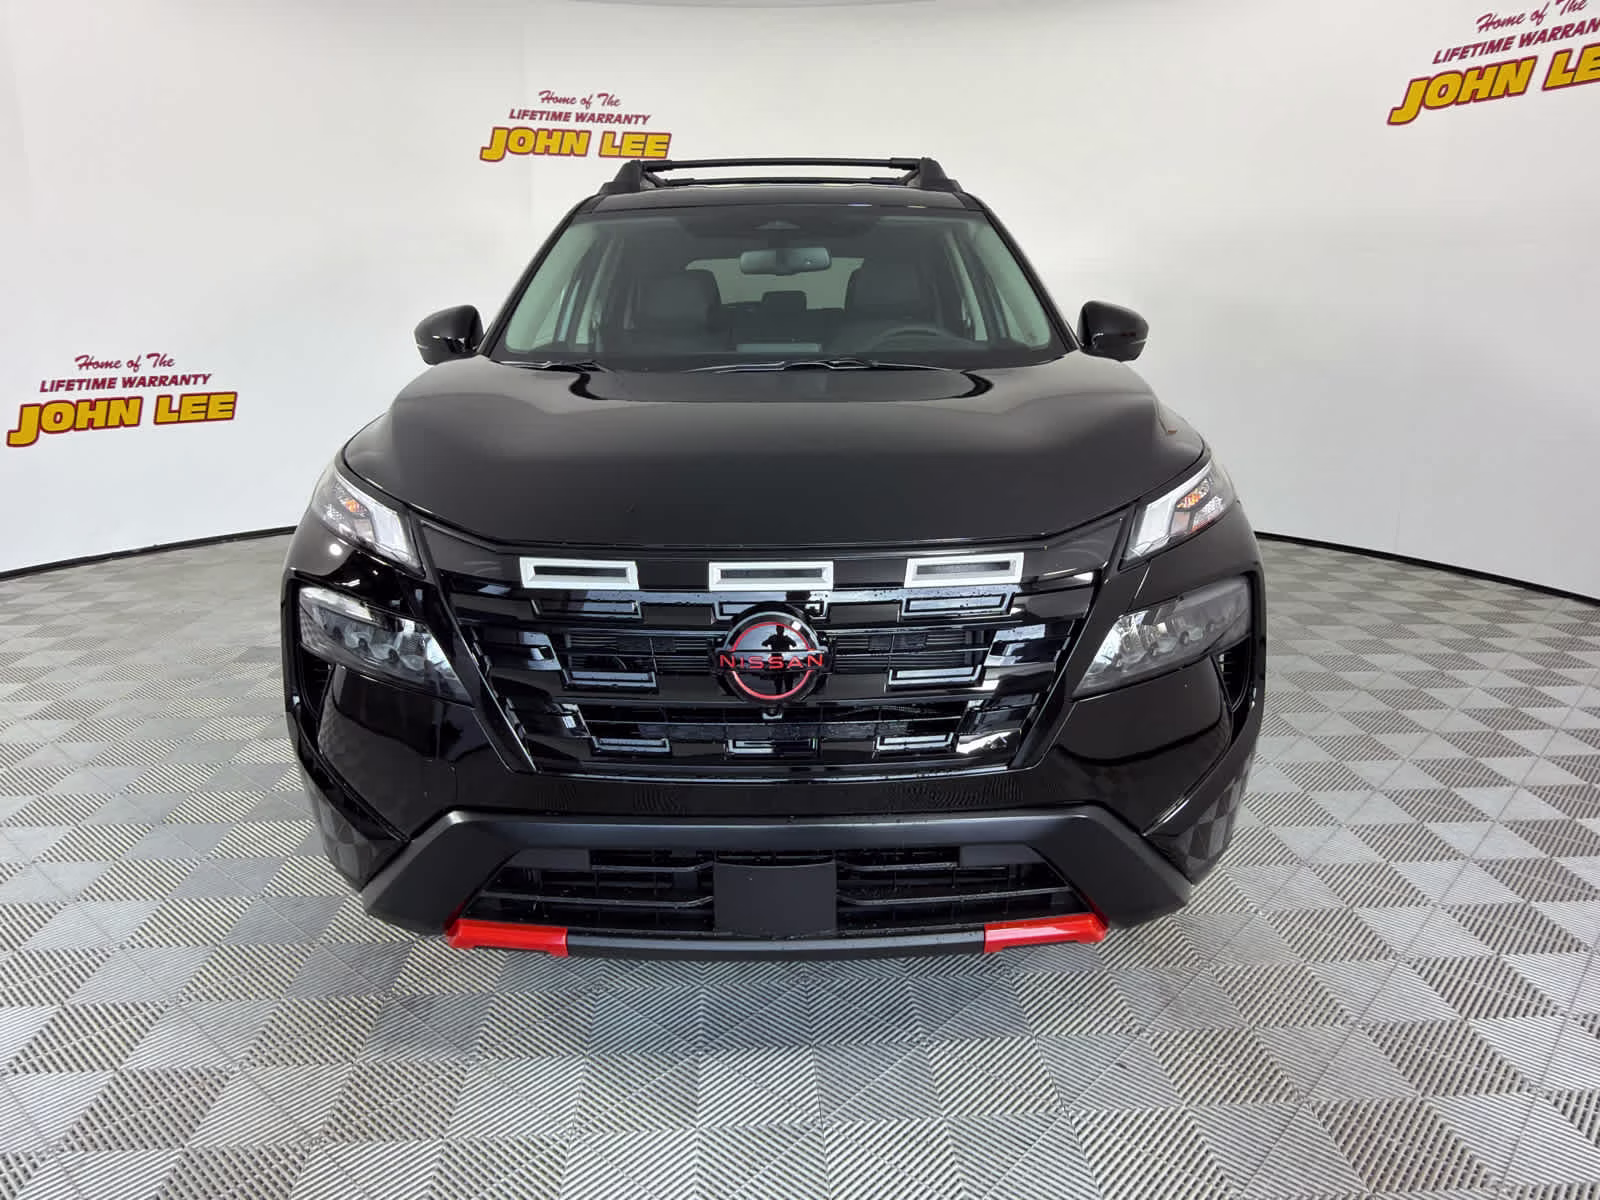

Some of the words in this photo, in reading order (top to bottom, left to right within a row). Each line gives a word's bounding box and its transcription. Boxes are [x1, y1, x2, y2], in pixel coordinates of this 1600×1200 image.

[1476, 13, 1525, 33] Home
[1530, 2, 1549, 25] of
[1555, 0, 1588, 16] The
[1432, 36, 1515, 64] LIFETIME
[539, 90, 577, 105] Home
[580, 94, 594, 109] of
[597, 93, 621, 107] The
[1387, 56, 1538, 125] JOHN
[509, 108, 571, 122] LIFETIME
[575, 112, 650, 125] WARRANTY
[480, 127, 592, 162] JOHN
[598, 131, 672, 159] LEE
[75, 354, 122, 371] Home
[126, 355, 141, 372] of
[147, 353, 175, 368] The
[40, 377, 117, 393] LIFETIME
[122, 373, 211, 388] WARRANTY
[7, 396, 143, 447] JOHN
[153, 391, 238, 425] LEE
[719, 654, 823, 669] NISSAN
